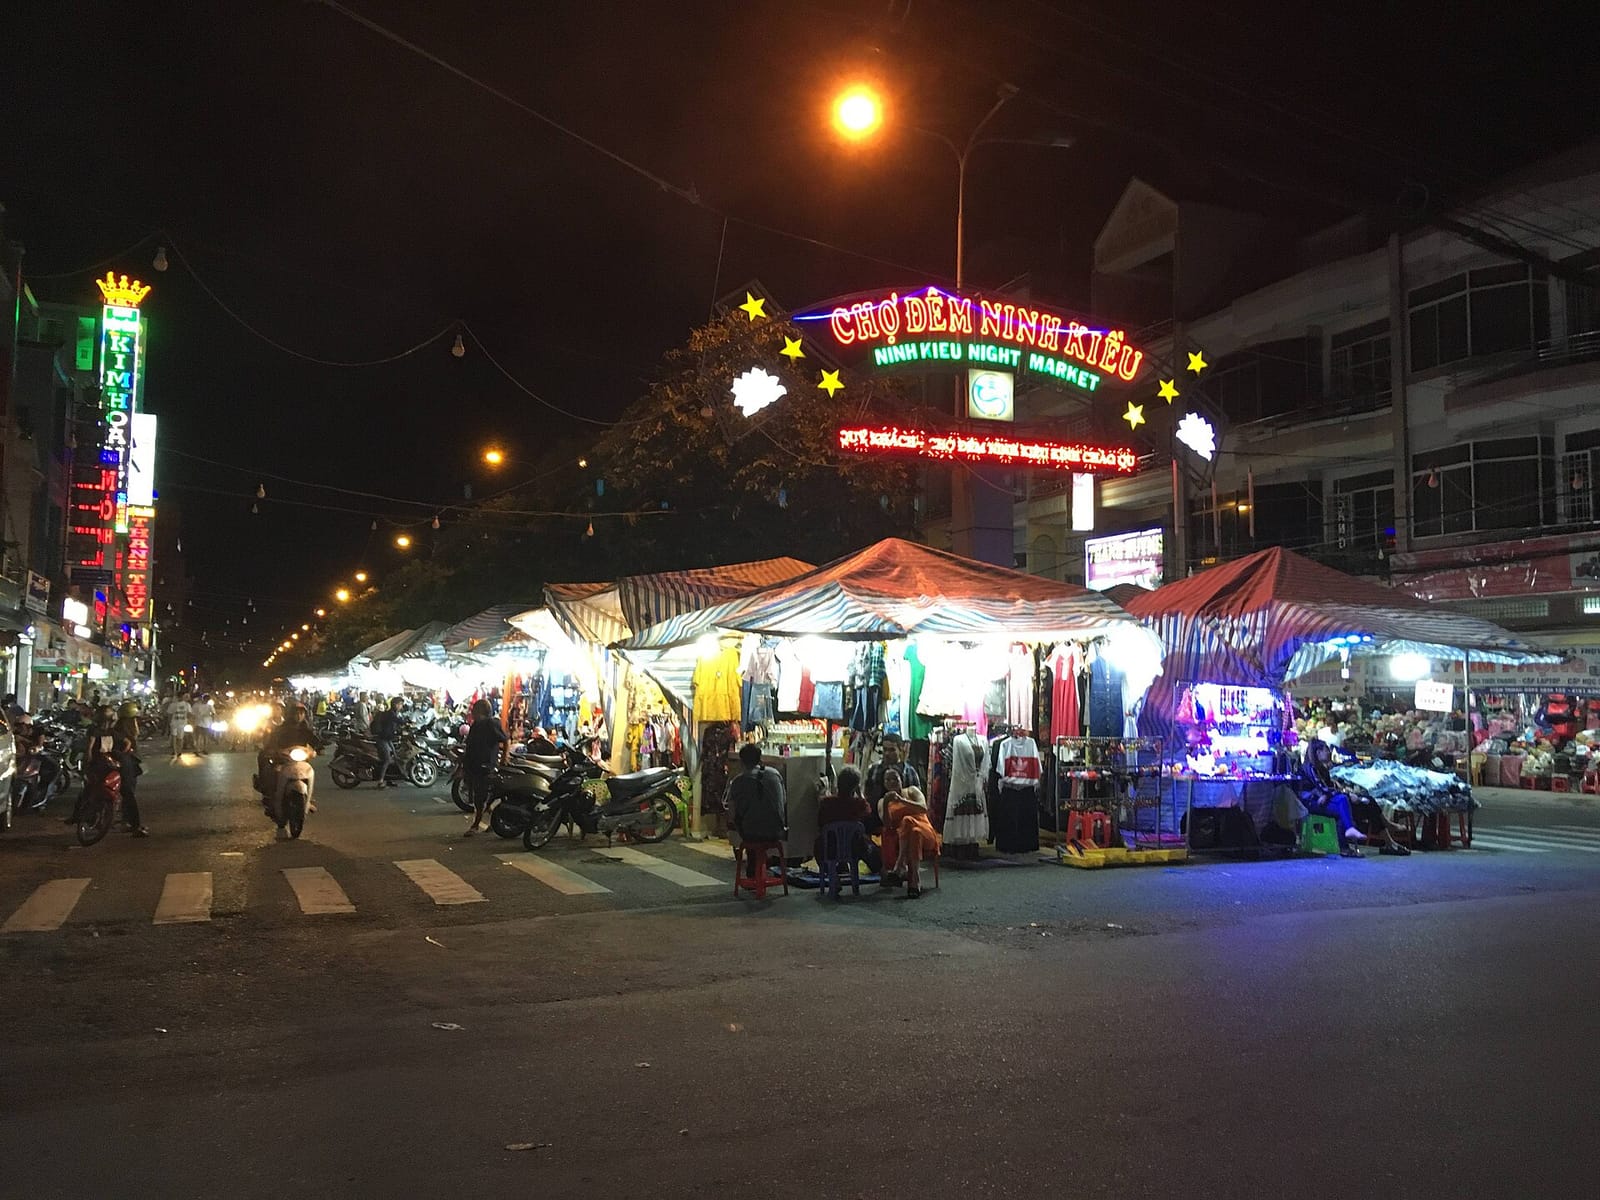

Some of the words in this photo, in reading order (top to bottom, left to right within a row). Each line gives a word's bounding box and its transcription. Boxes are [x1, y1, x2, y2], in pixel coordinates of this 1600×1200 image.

[831, 292, 900, 344] CHỢ
[904, 286, 973, 333] ĐÊM
[980, 299, 1062, 351] NINH
[1064, 321, 1143, 381] KIỀU
[106, 335, 131, 388] KIM
[874, 343, 918, 366] NINH
[919, 341, 962, 360] KIEU
[968, 344, 1021, 367] NIGHT
[1029, 353, 1100, 392] MARKET
[127, 517, 150, 570] THANH
